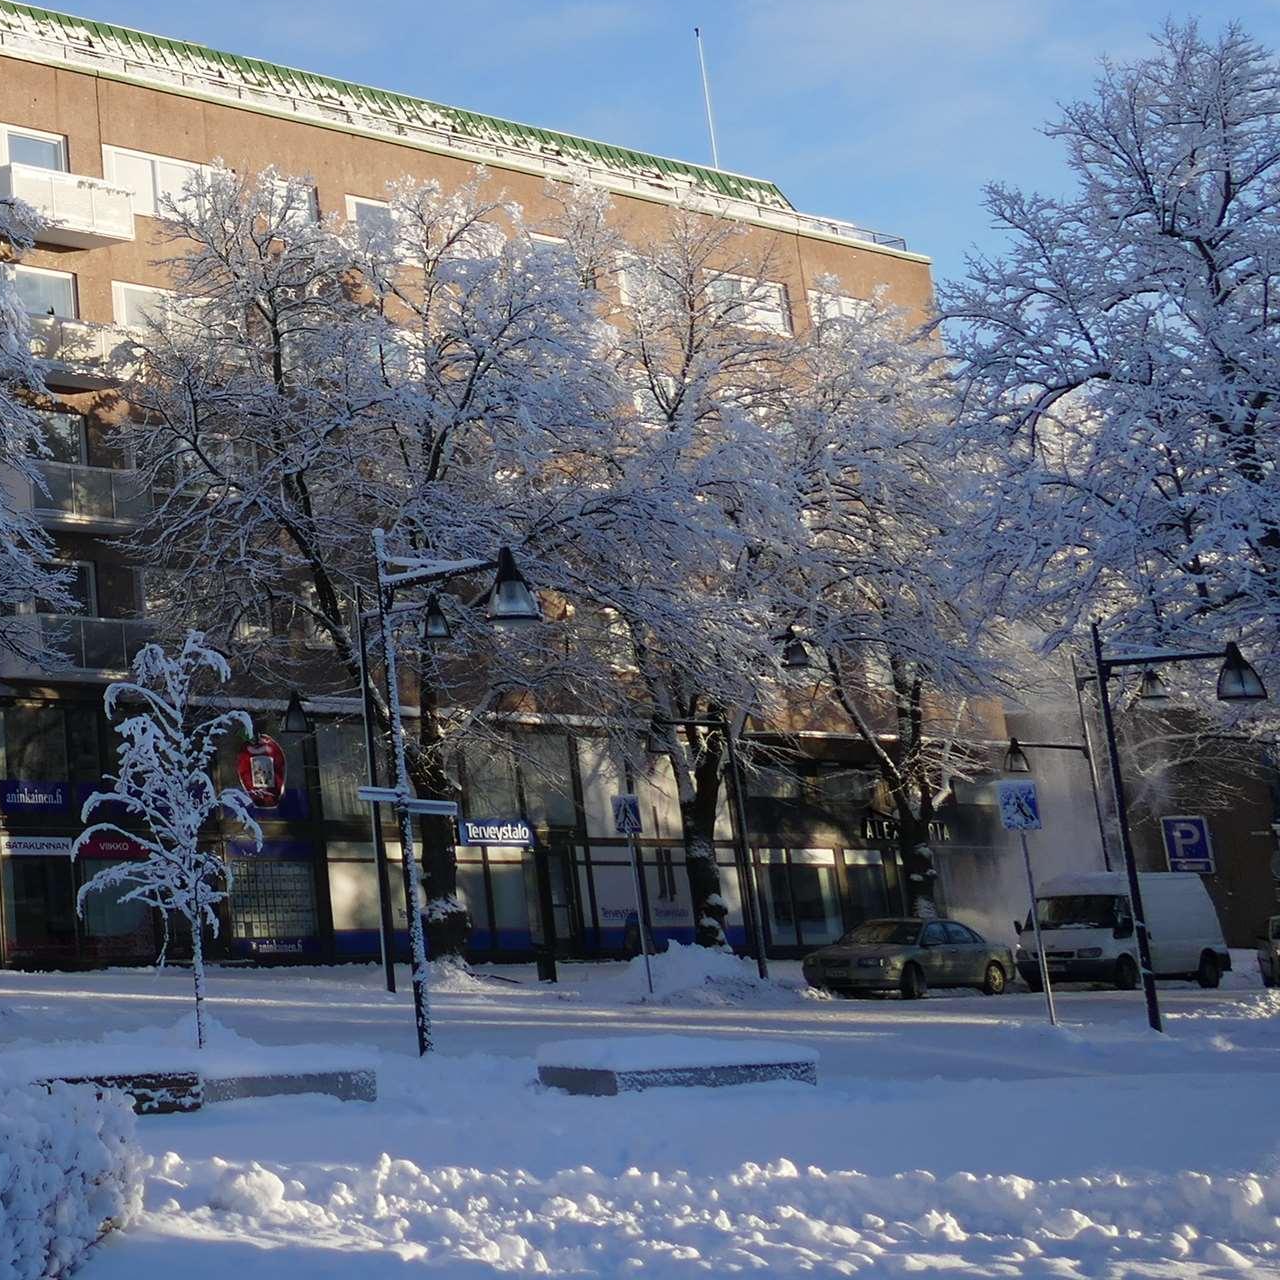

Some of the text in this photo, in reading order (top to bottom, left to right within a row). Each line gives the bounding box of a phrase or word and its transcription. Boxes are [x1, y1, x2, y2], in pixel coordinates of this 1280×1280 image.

[5, 787, 63, 805] aninkainen.fi
[465, 822, 530, 840] Terveystalo
[1173, 822, 1200, 858] P
[5, 841, 70, 851] SATAKUNNAN
[98, 842, 130, 852] VIIKKO
